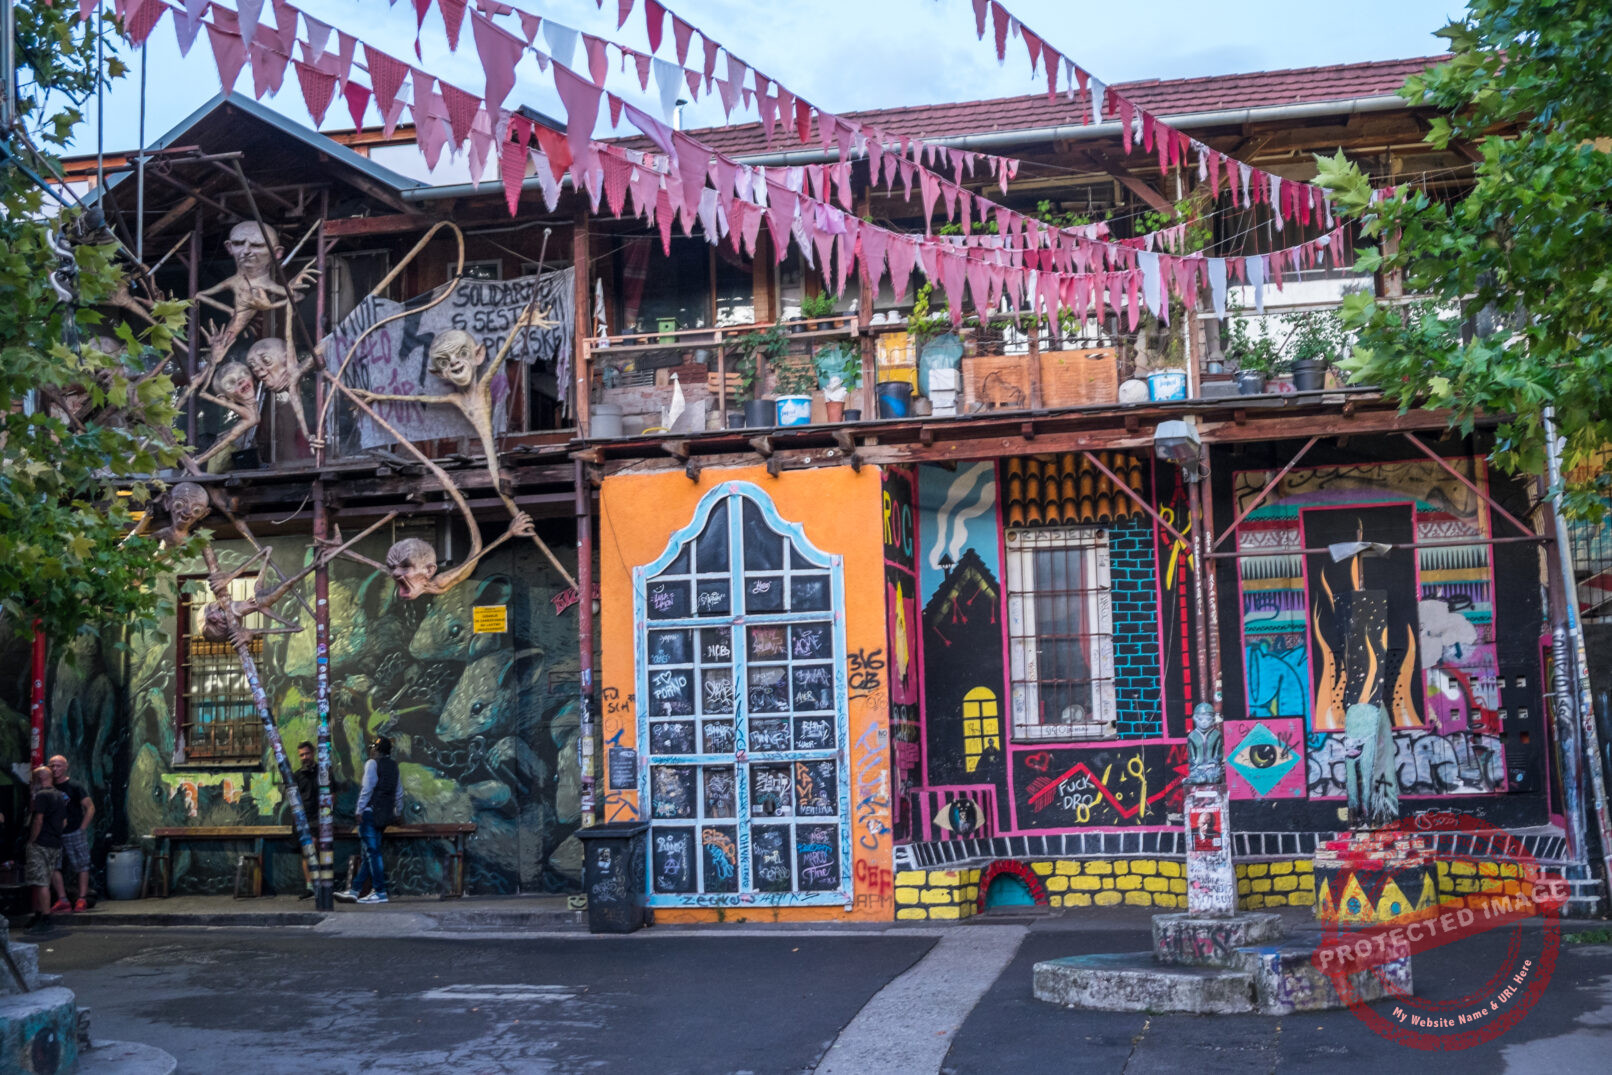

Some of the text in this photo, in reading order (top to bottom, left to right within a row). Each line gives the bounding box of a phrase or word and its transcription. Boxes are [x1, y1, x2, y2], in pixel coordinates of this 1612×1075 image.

[883, 490, 913, 557] ROG
[653, 676, 687, 700] PORNO
[1058, 773, 1095, 796] FUCK
